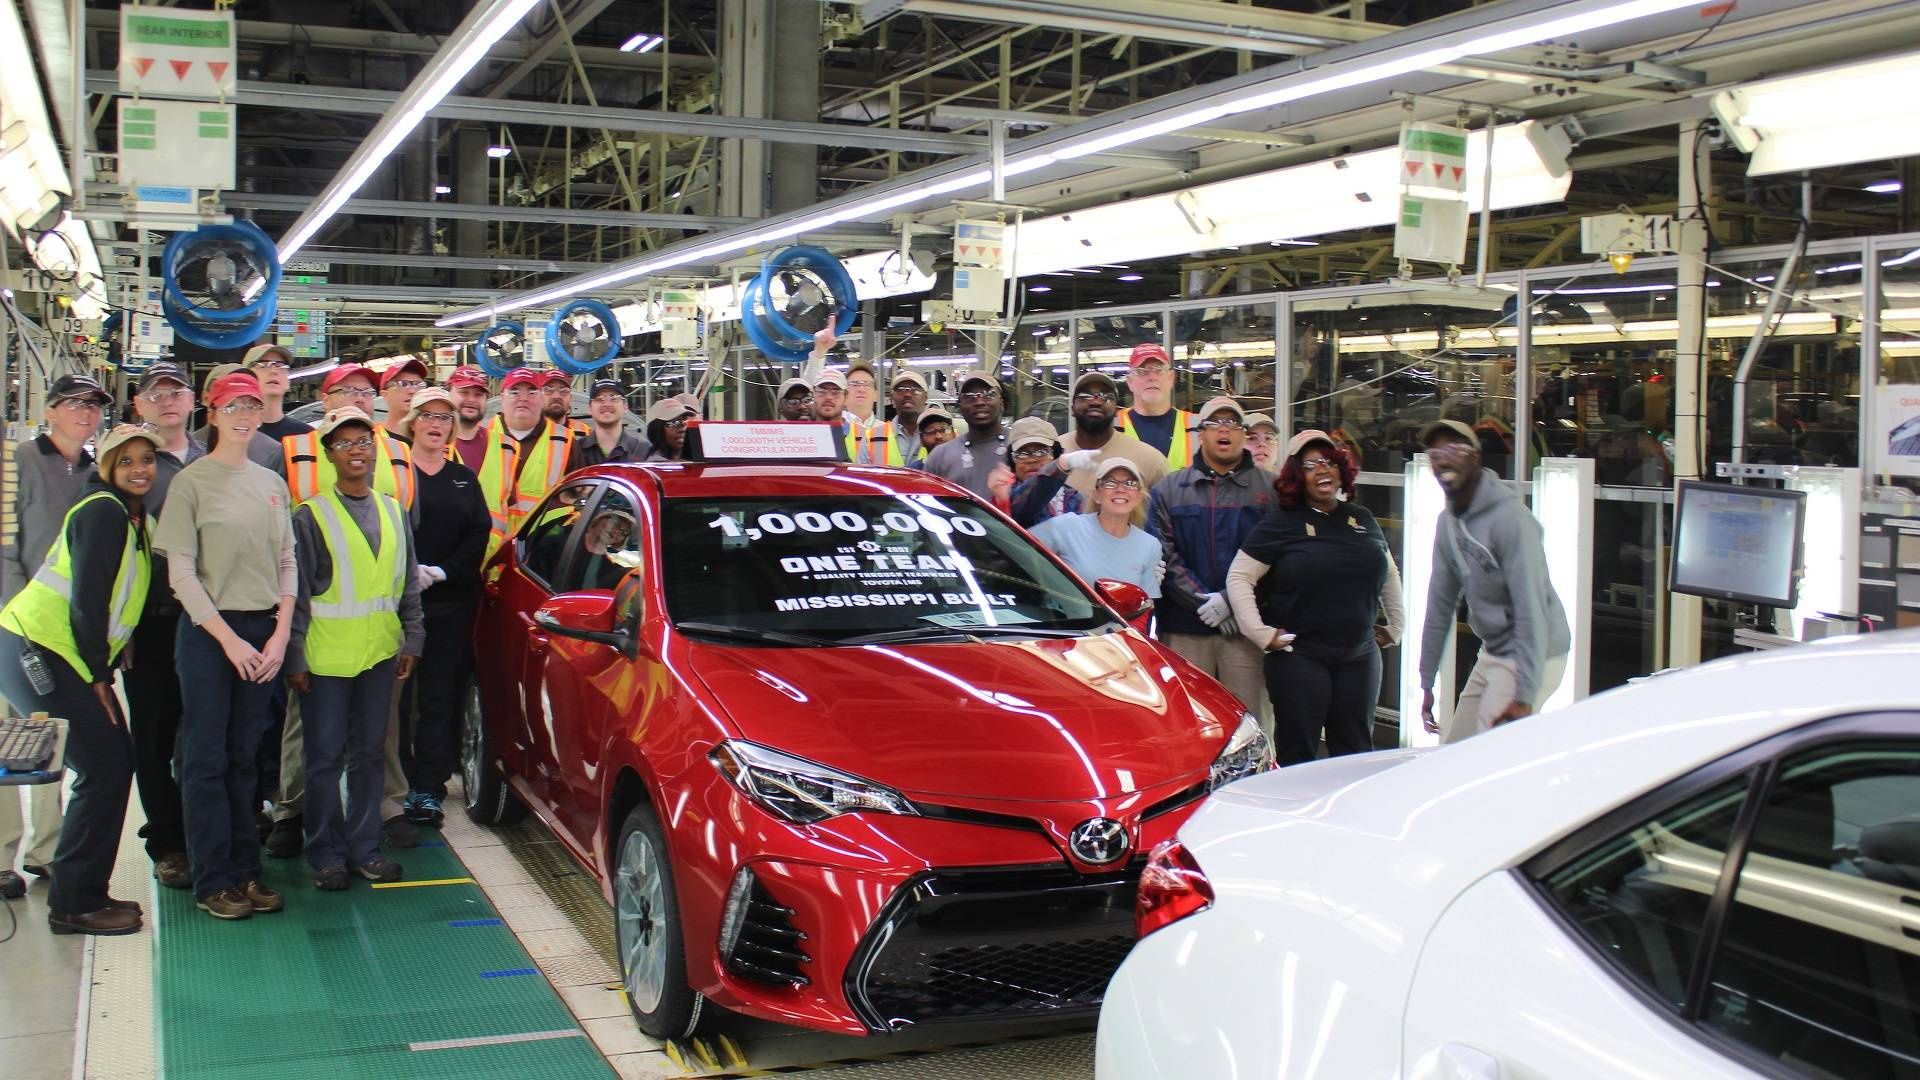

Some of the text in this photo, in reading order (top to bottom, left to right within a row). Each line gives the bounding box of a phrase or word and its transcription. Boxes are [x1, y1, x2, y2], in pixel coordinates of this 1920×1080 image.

[136, 25, 223, 39] REAR INTERIOR
[1645, 217, 1671, 250] 11
[23, 269, 53, 290] 10
[63, 318, 82, 333] 09
[777, 437, 816, 445] VEHICLE
[708, 512, 987, 541] 1,000,000
[780, 554, 976, 573] ONE TEAM
[774, 593, 1017, 612] MISSISSIPPI BULT
